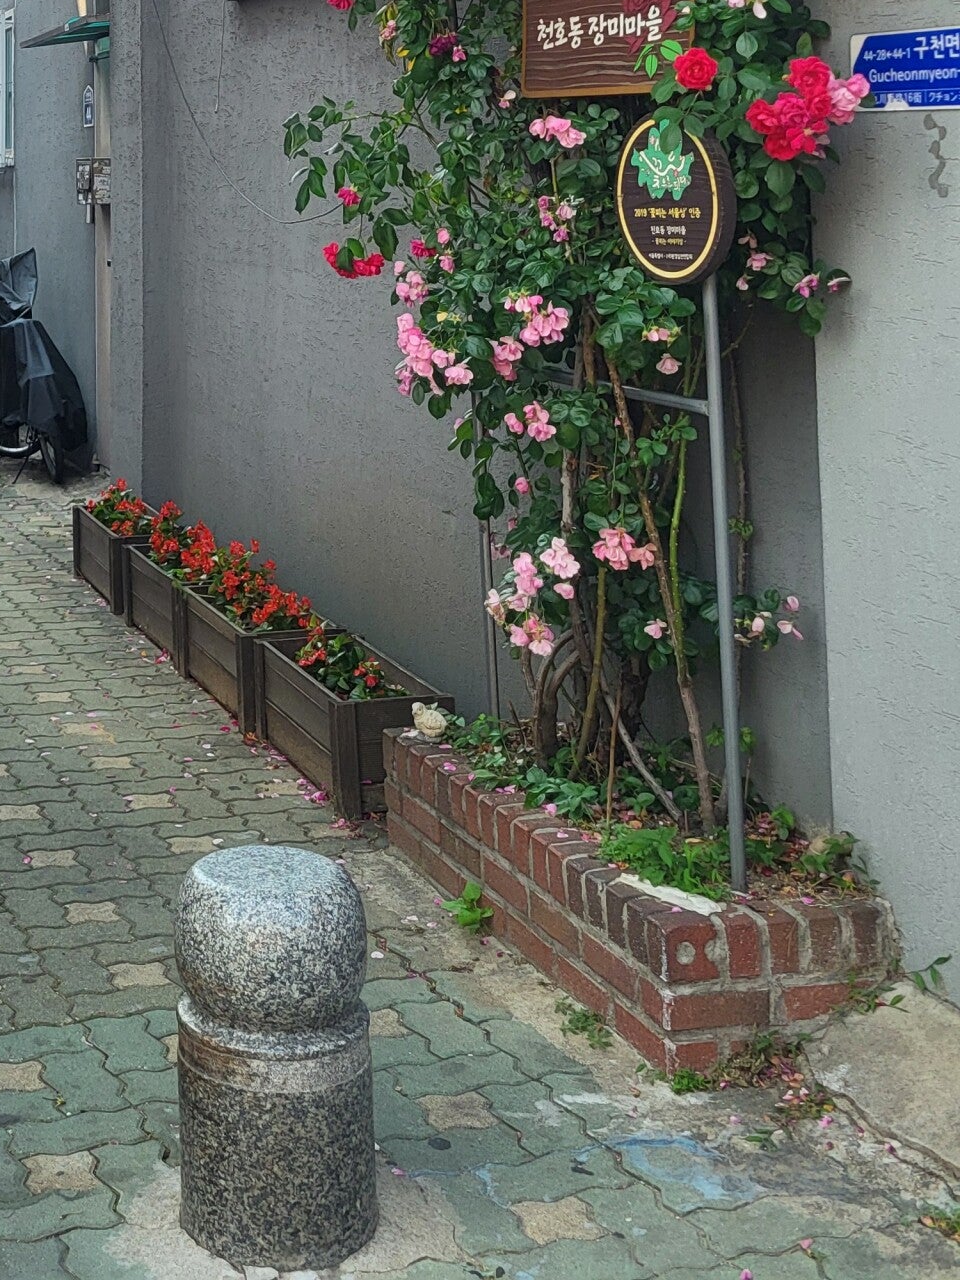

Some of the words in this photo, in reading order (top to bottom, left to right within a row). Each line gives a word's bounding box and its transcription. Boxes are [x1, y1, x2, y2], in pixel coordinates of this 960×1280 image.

[537, 16, 584, 50] 천호동
[588, 5, 663, 46] 장미마을
[913, 33, 960, 59] 구천면
[688, 207, 701, 218] 인증
